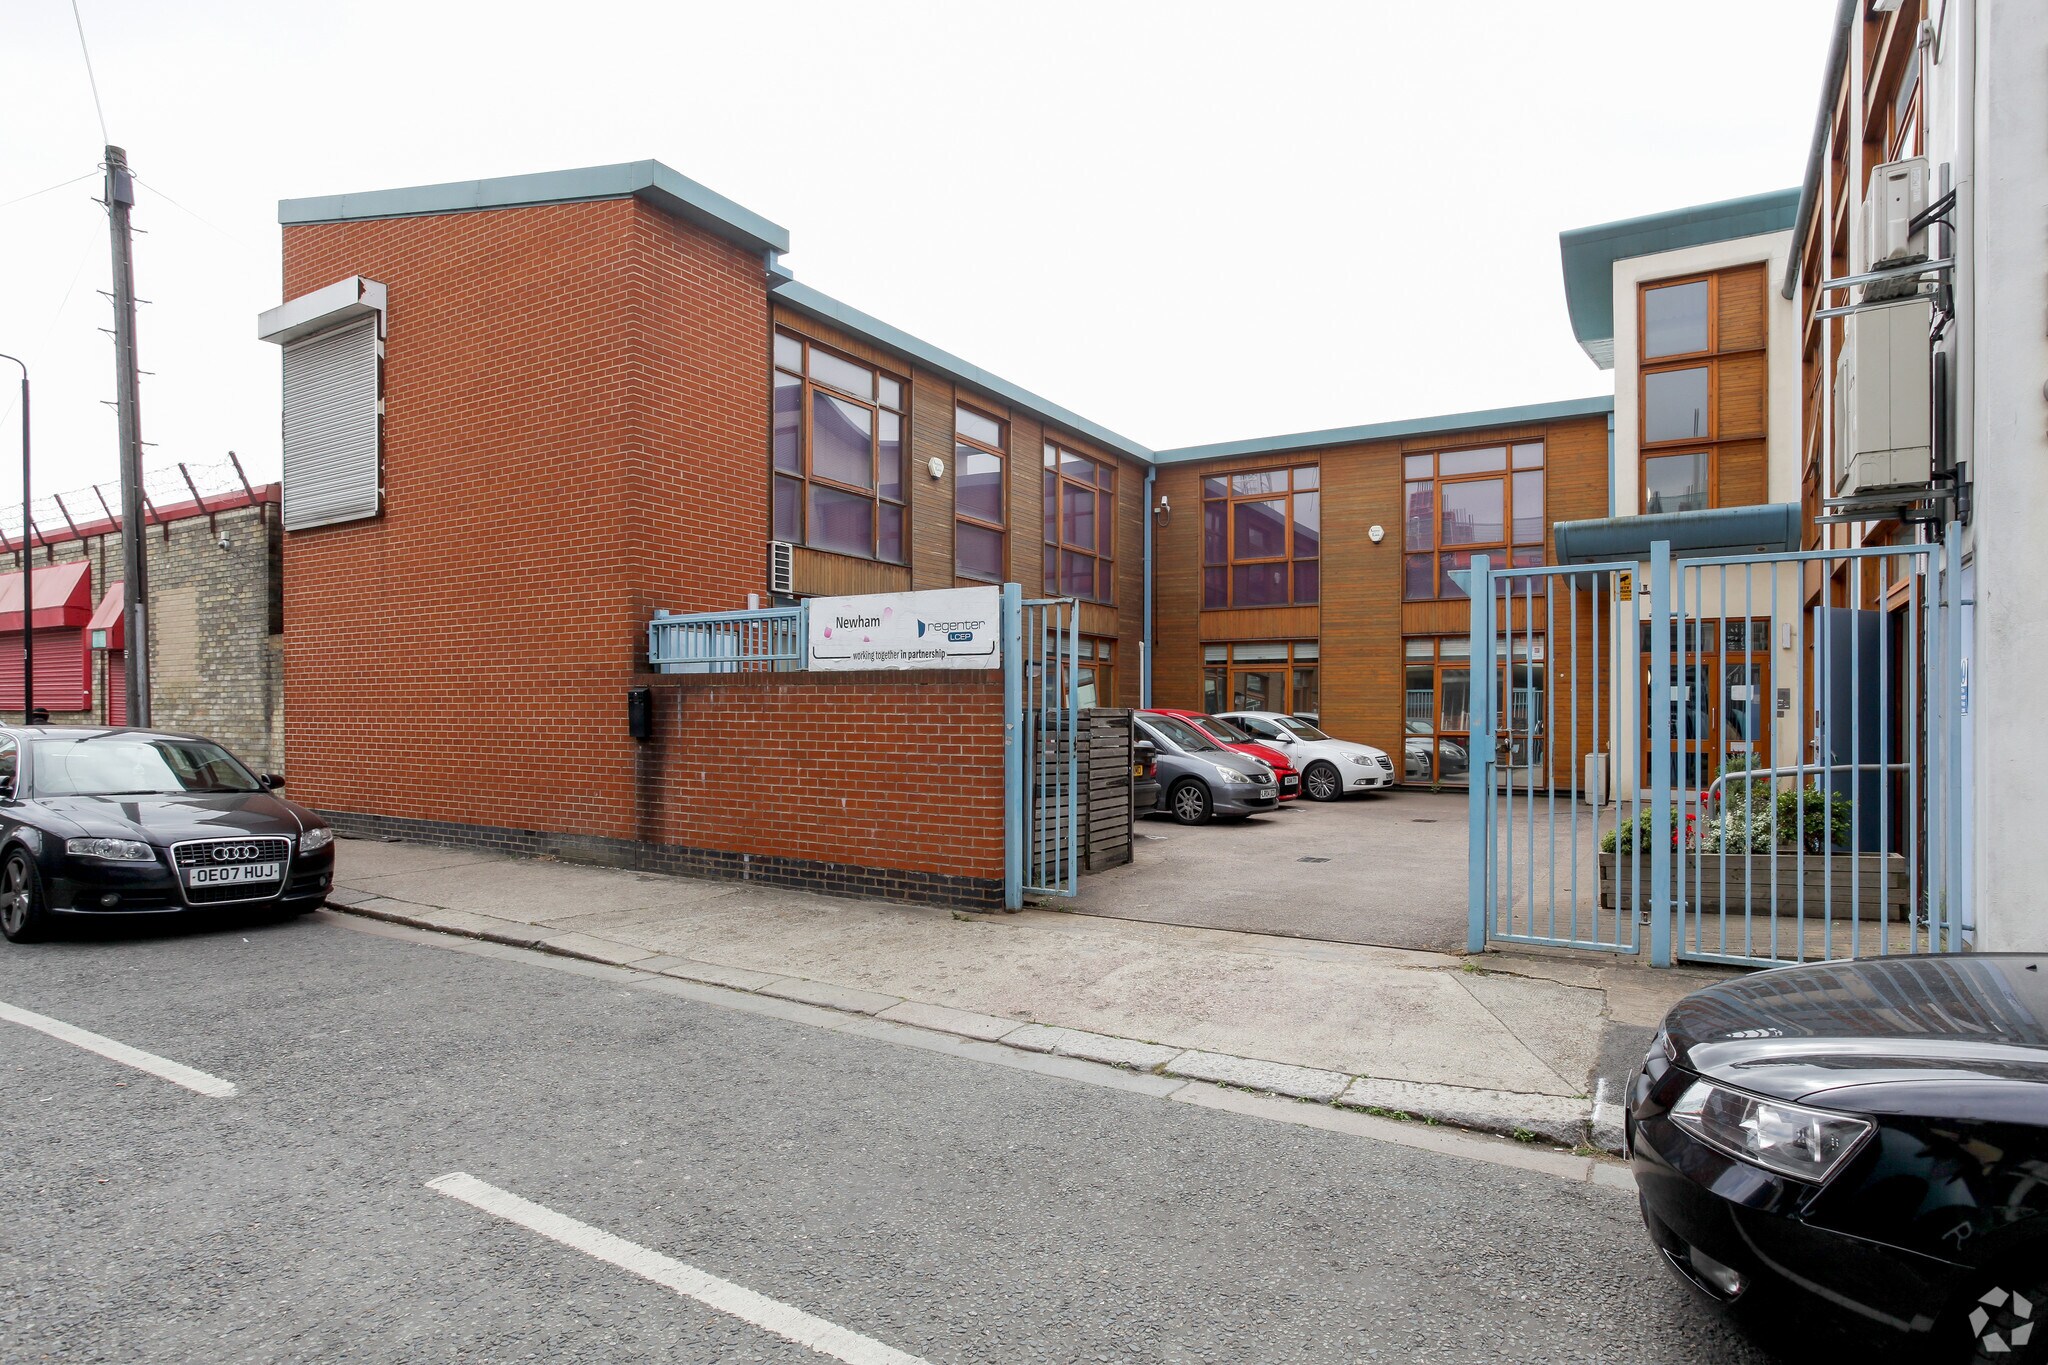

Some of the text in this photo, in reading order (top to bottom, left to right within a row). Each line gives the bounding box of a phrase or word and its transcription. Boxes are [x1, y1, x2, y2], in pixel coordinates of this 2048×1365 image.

[836, 614, 880, 629] Newham
[927, 620, 986, 634] regenter
[950, 633, 971, 641] LCEP
[852, 648, 946, 662] working together in partnership
[197, 865, 273, 882] OE07 HUJ
